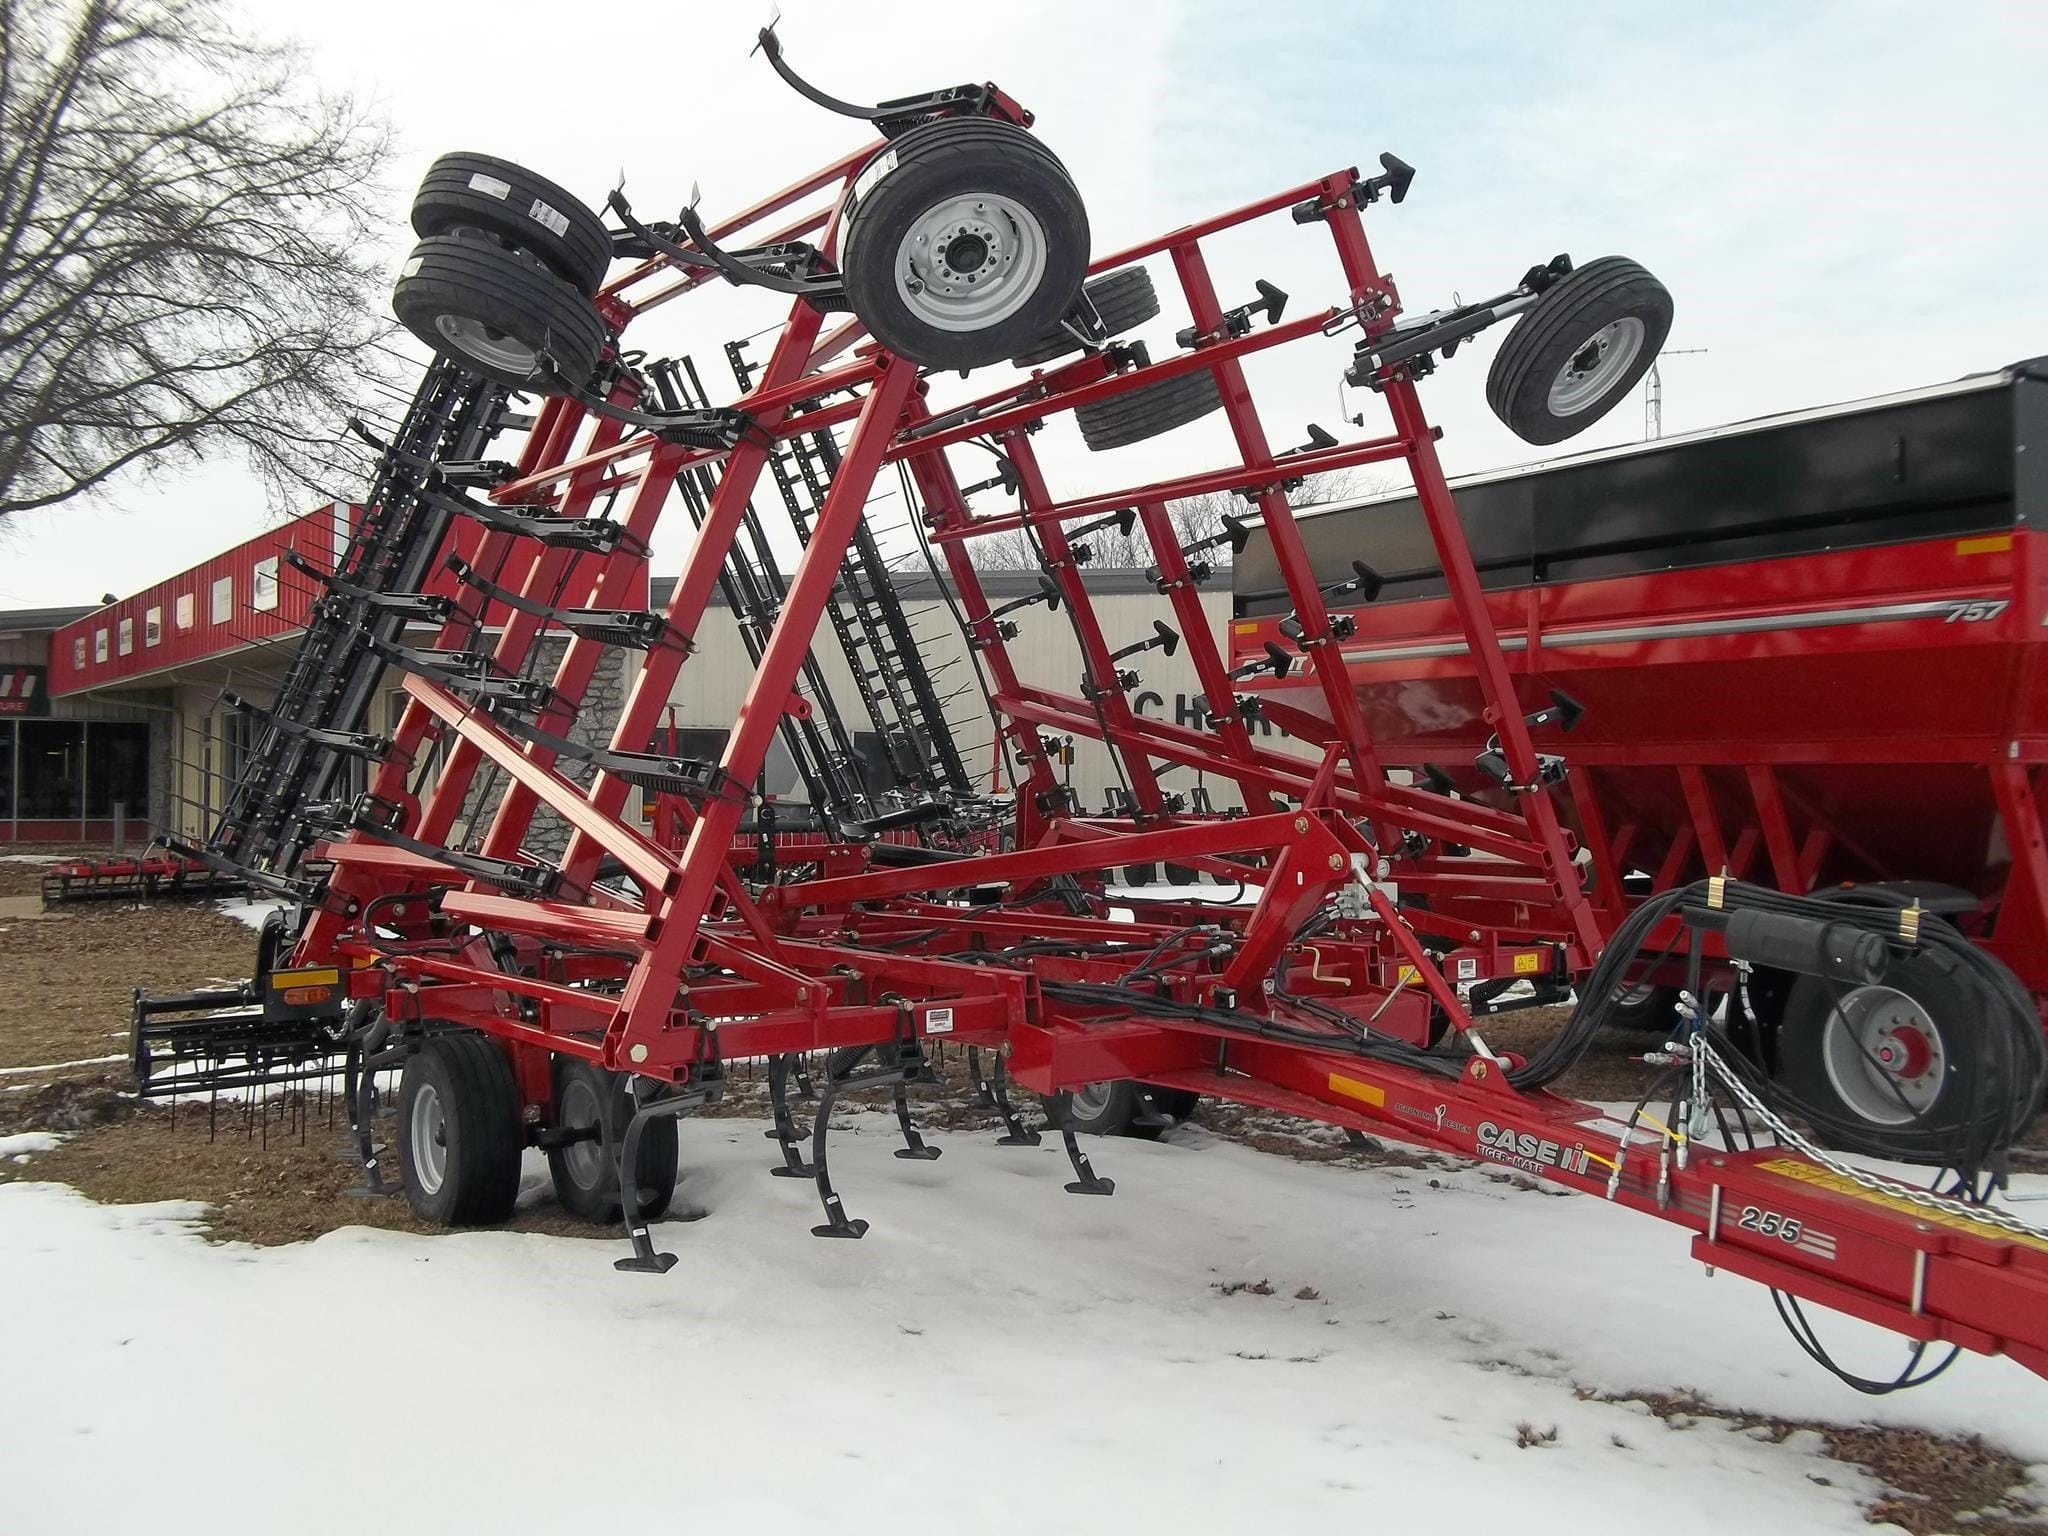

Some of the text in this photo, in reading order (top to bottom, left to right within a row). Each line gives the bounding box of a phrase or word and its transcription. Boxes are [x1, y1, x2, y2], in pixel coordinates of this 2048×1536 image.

[1945, 600, 2011, 623] 757
[1395, 1103, 1471, 1134] AGRONOMIC DESIGN
[1476, 1143, 1545, 1173] TIGER-MATE
[1477, 1121, 1559, 1165] CASE
[1738, 1206, 1802, 1244] 255
